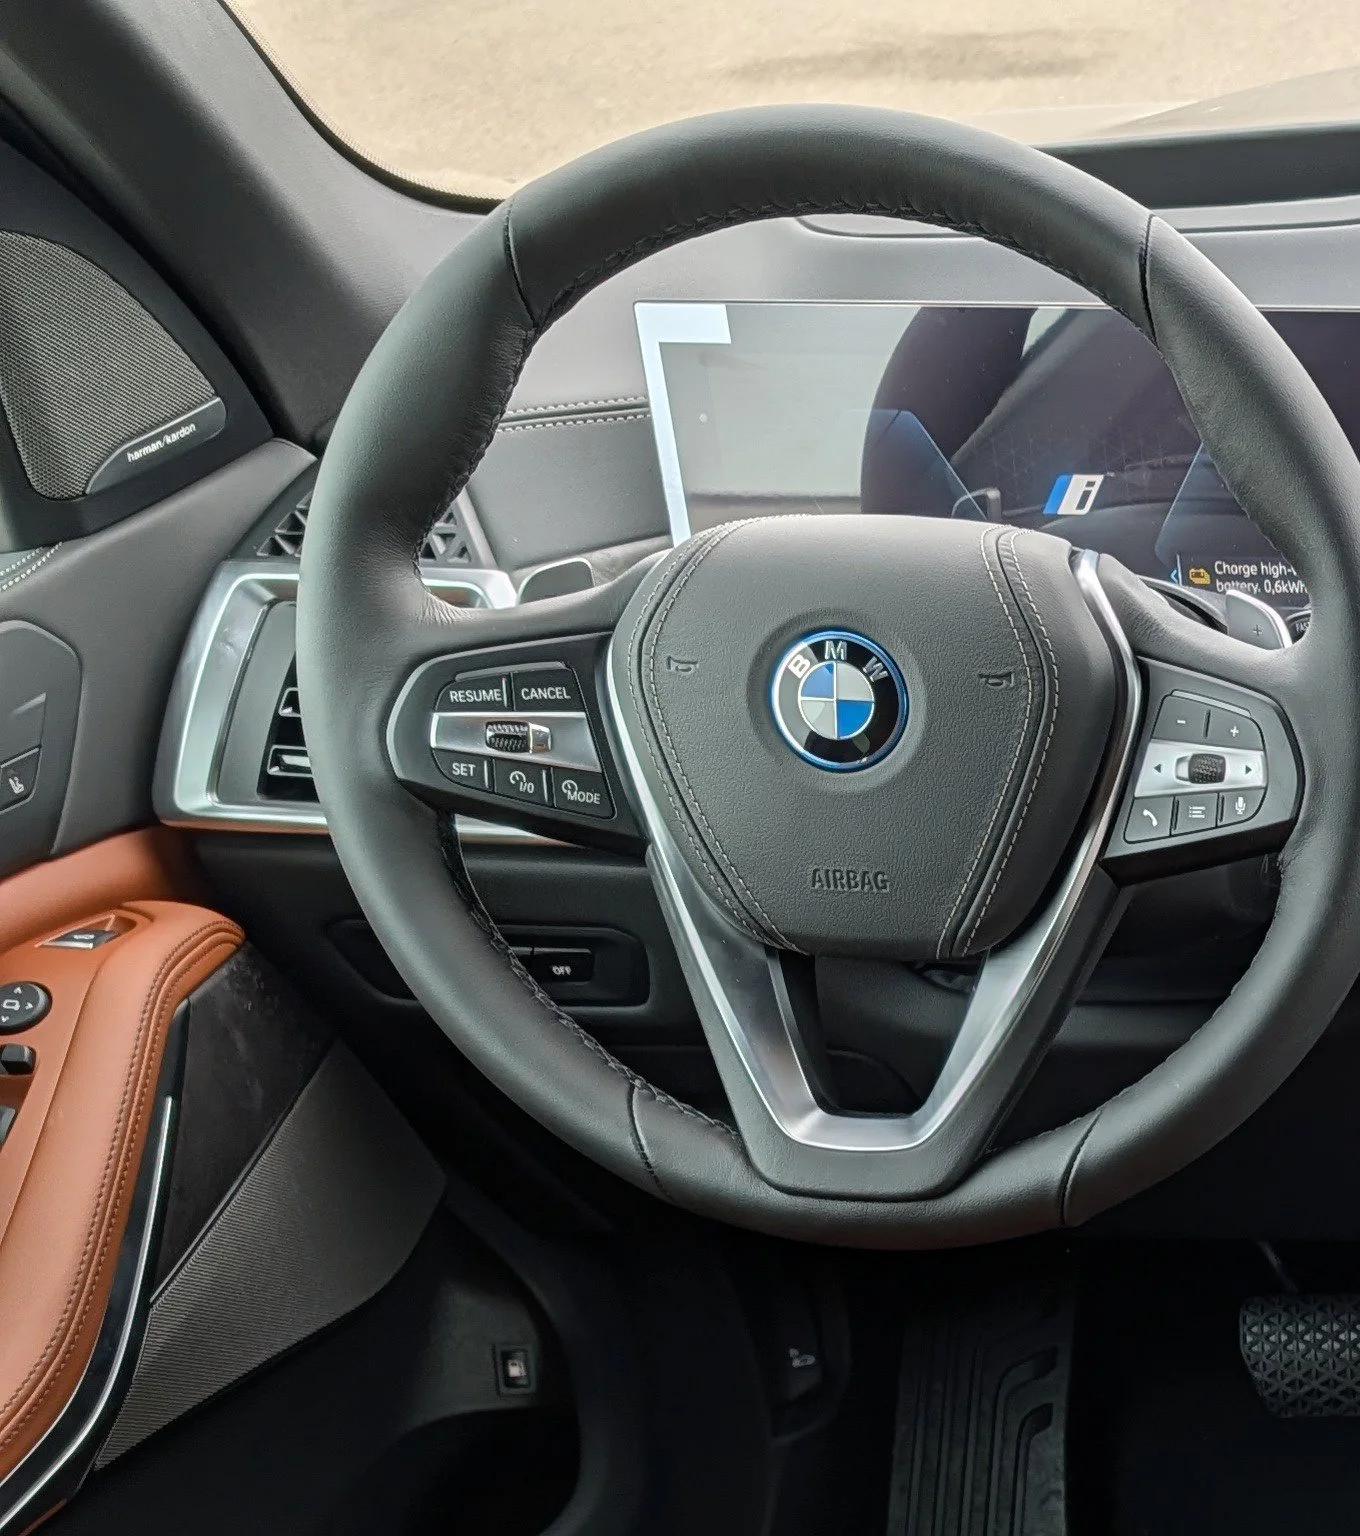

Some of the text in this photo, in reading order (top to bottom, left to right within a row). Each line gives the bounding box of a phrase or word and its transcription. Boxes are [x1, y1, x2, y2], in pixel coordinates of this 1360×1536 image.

[127, 423, 196, 463] harman/kardon
[1214, 560, 1258, 578] Charge
[787, 640, 889, 683] BMW
[450, 686, 571, 703] RESUME CANCEL
[452, 762, 476, 777] SET
[567, 790, 601, 805] MODE
[811, 867, 890, 893] AIRBAG
